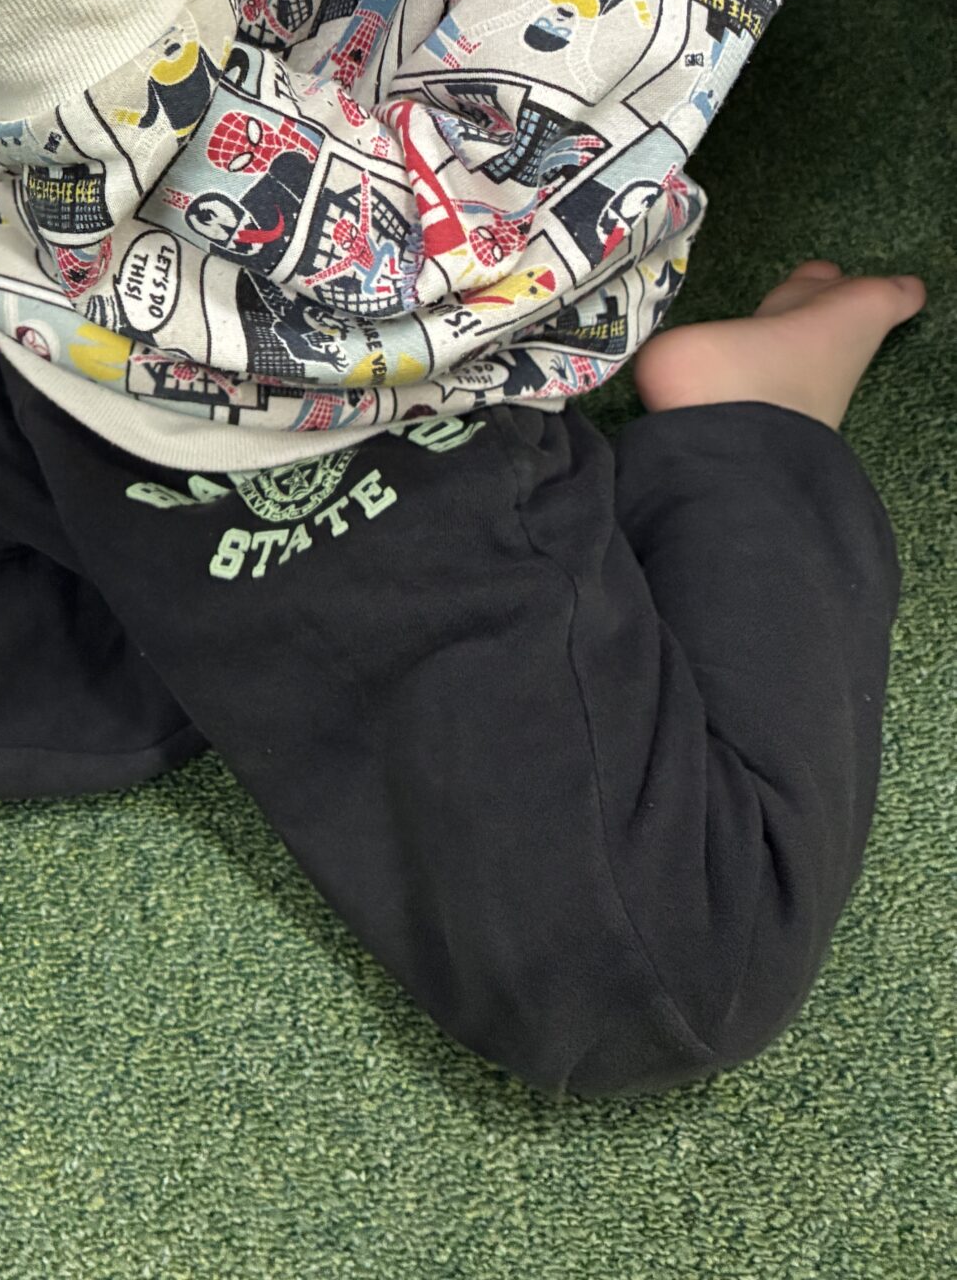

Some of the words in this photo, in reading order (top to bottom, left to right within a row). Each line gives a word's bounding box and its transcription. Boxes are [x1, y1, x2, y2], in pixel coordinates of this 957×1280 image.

[124, 254, 149, 300] THIS!
[153, 245, 175, 291] LET'S
[149, 293, 165, 318] DO
[209, 468, 398, 580] STATE
